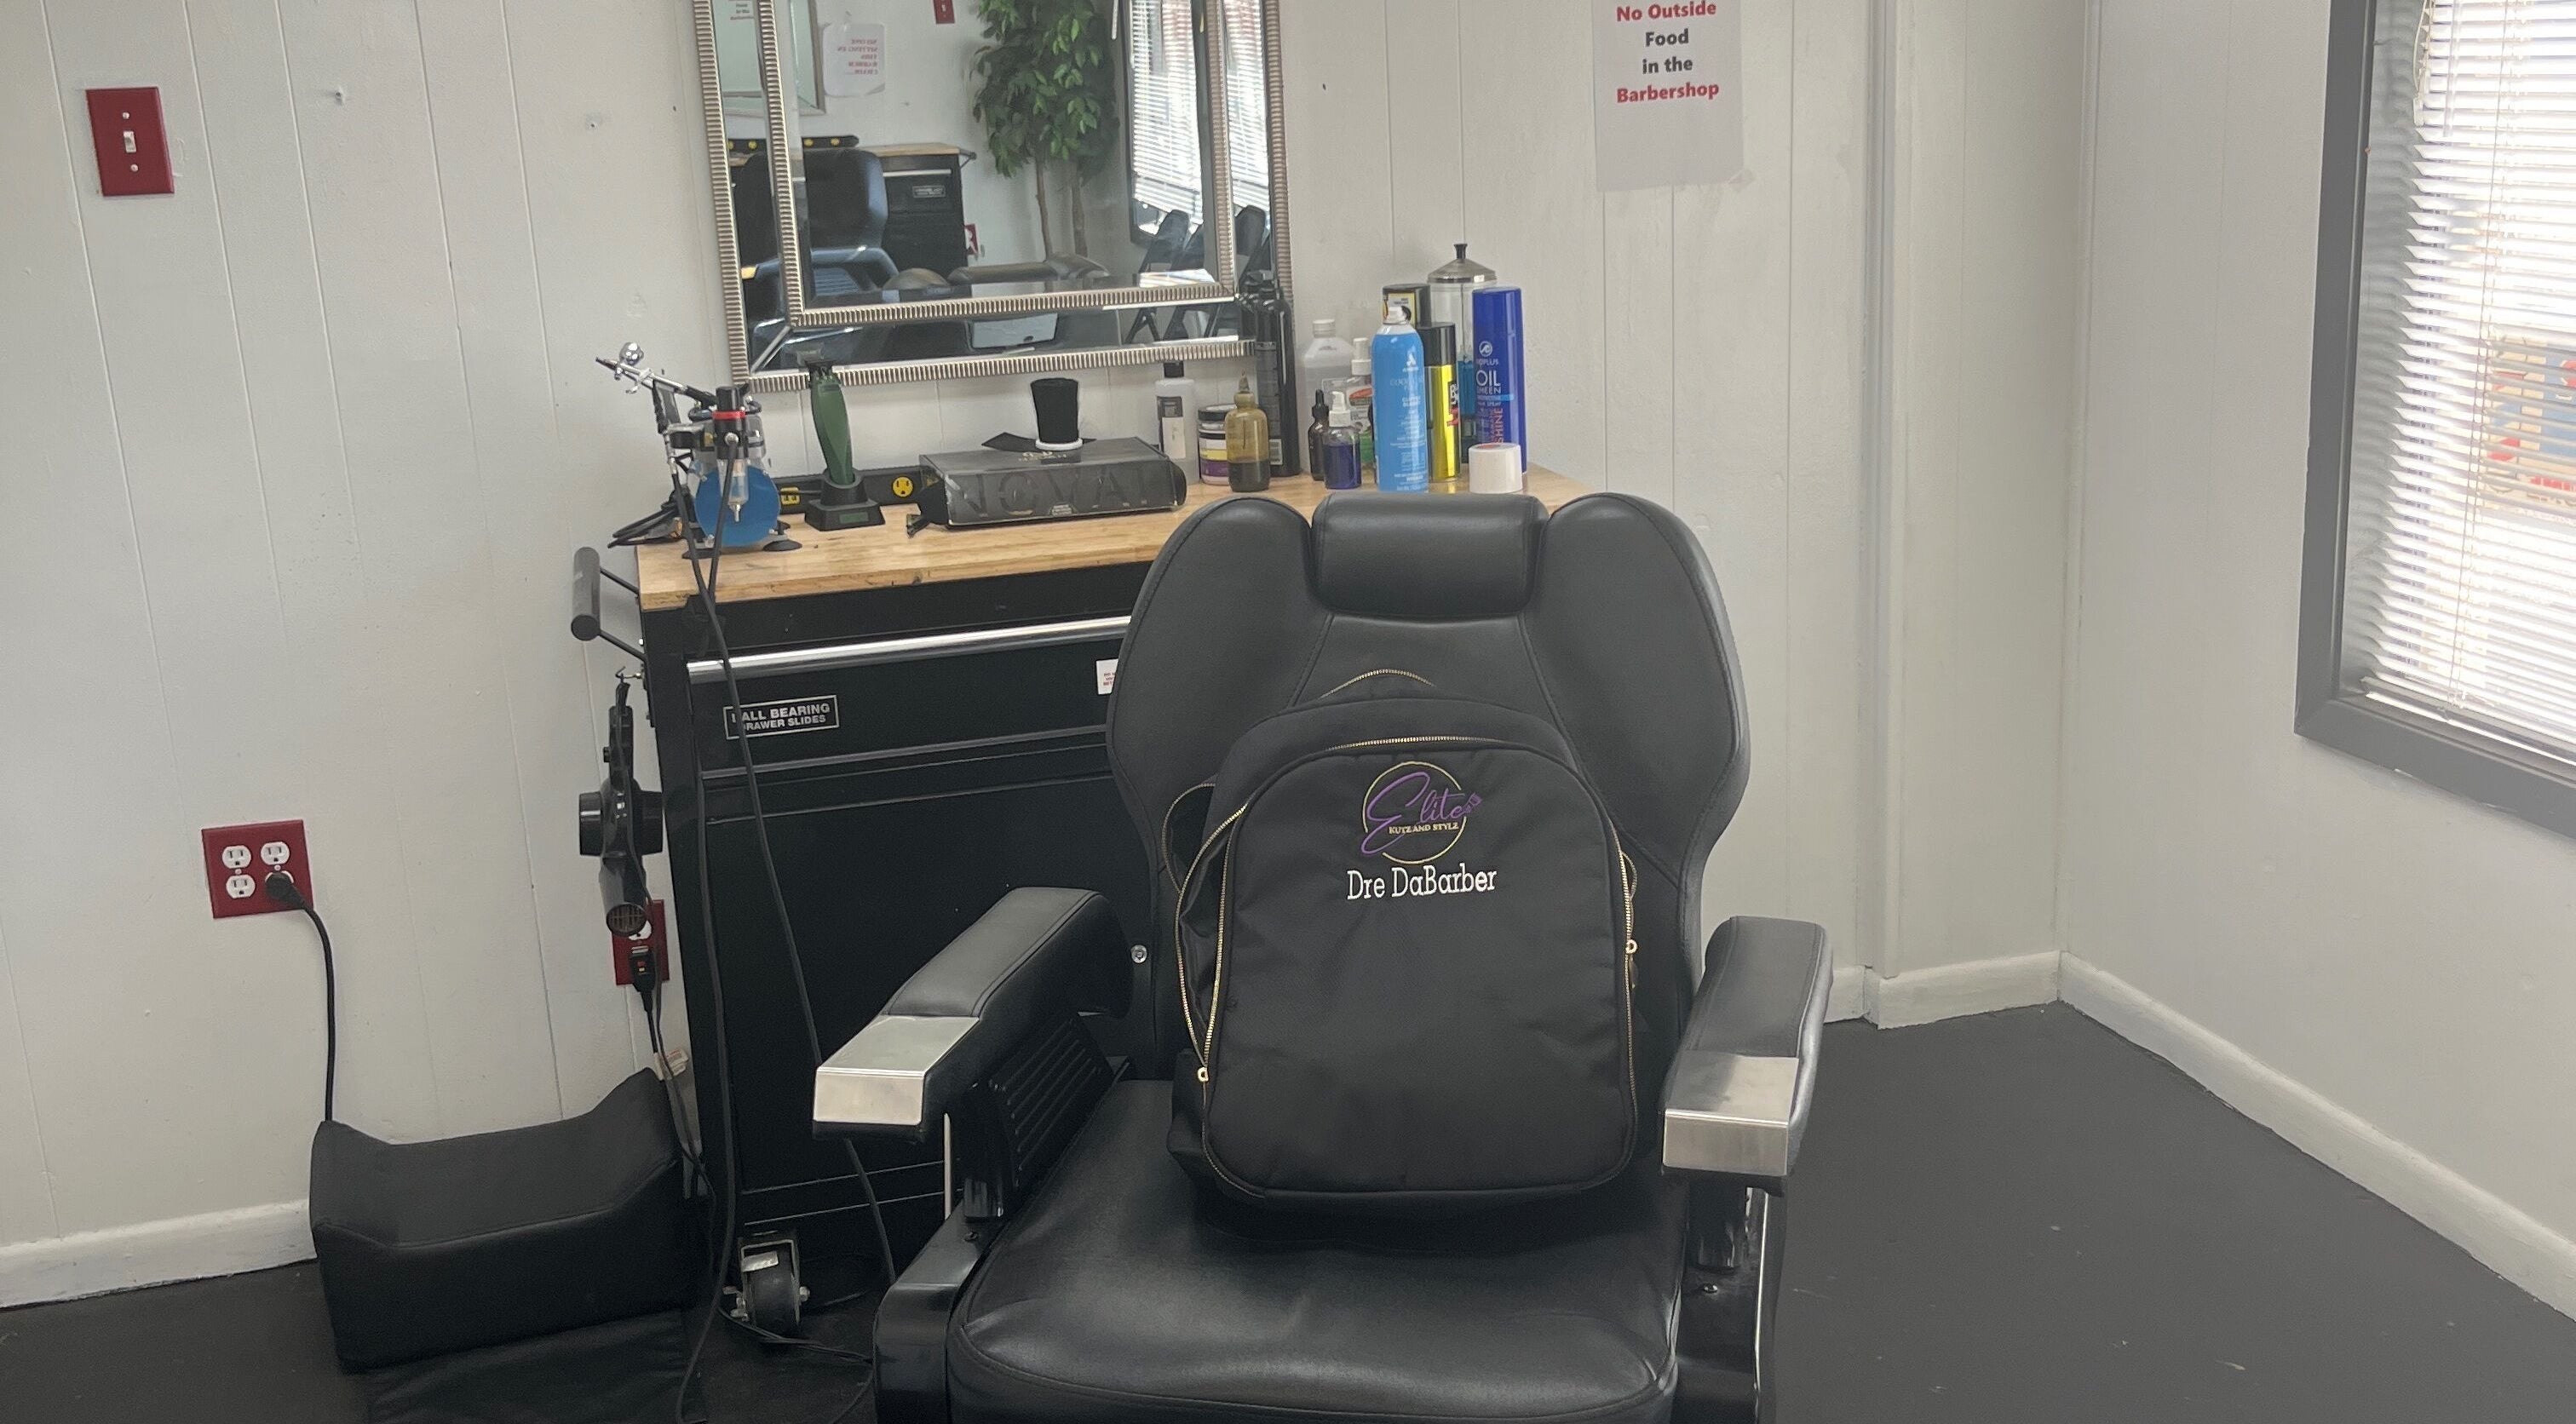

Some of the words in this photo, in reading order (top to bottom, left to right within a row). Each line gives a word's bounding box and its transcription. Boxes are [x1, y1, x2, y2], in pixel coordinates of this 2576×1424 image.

[1617, 6, 1642, 22] No
[1648, 0, 1717, 20] Outside
[1645, 28, 1690, 47] Food
[1642, 59, 1659, 74] in
[1665, 56, 1693, 72] the
[1617, 82, 1720, 104] Barbershop
[1476, 370, 1501, 387] OIL
[770, 703, 831, 719] BEARING
[744, 719, 785, 731] RAWER
[788, 715, 826, 726] SLIDES
[1361, 771, 1466, 856] Elite
[1347, 869, 1385, 900] Dre
[1391, 862, 1498, 898] DaBarber
